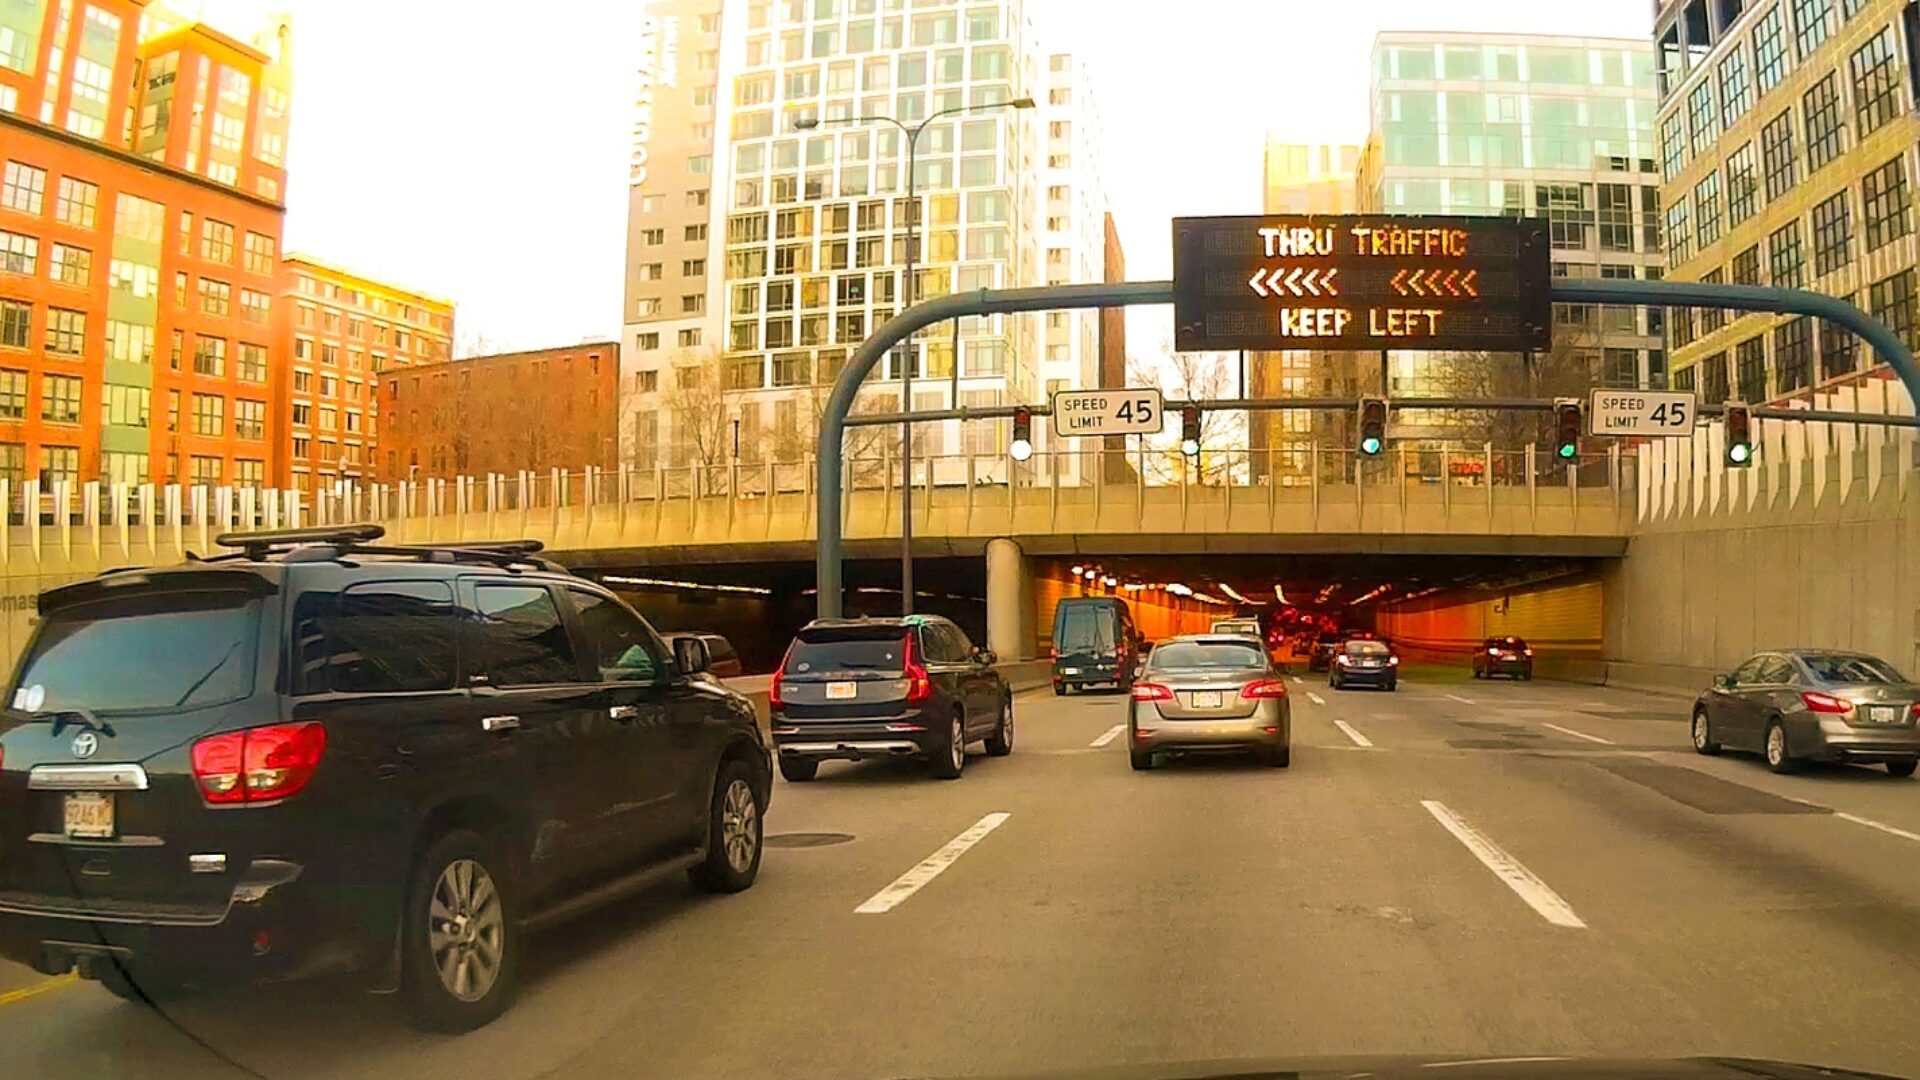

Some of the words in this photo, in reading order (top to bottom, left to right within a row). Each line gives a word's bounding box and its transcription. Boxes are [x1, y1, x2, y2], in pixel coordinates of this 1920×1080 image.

[1258, 227, 1334, 257] THRU
[1351, 227, 1469, 257] TRAFFIC
[1280, 307, 1351, 337] KEEP
[1369, 308, 1443, 337] LEFT
[1064, 398, 1108, 411] SPEED
[1115, 400, 1153, 424] 45
[1602, 398, 1645, 411] SPEED
[1069, 416, 1104, 429] LIMIT
[1605, 416, 1638, 428] LIMIT
[1650, 402, 1685, 427] 45
